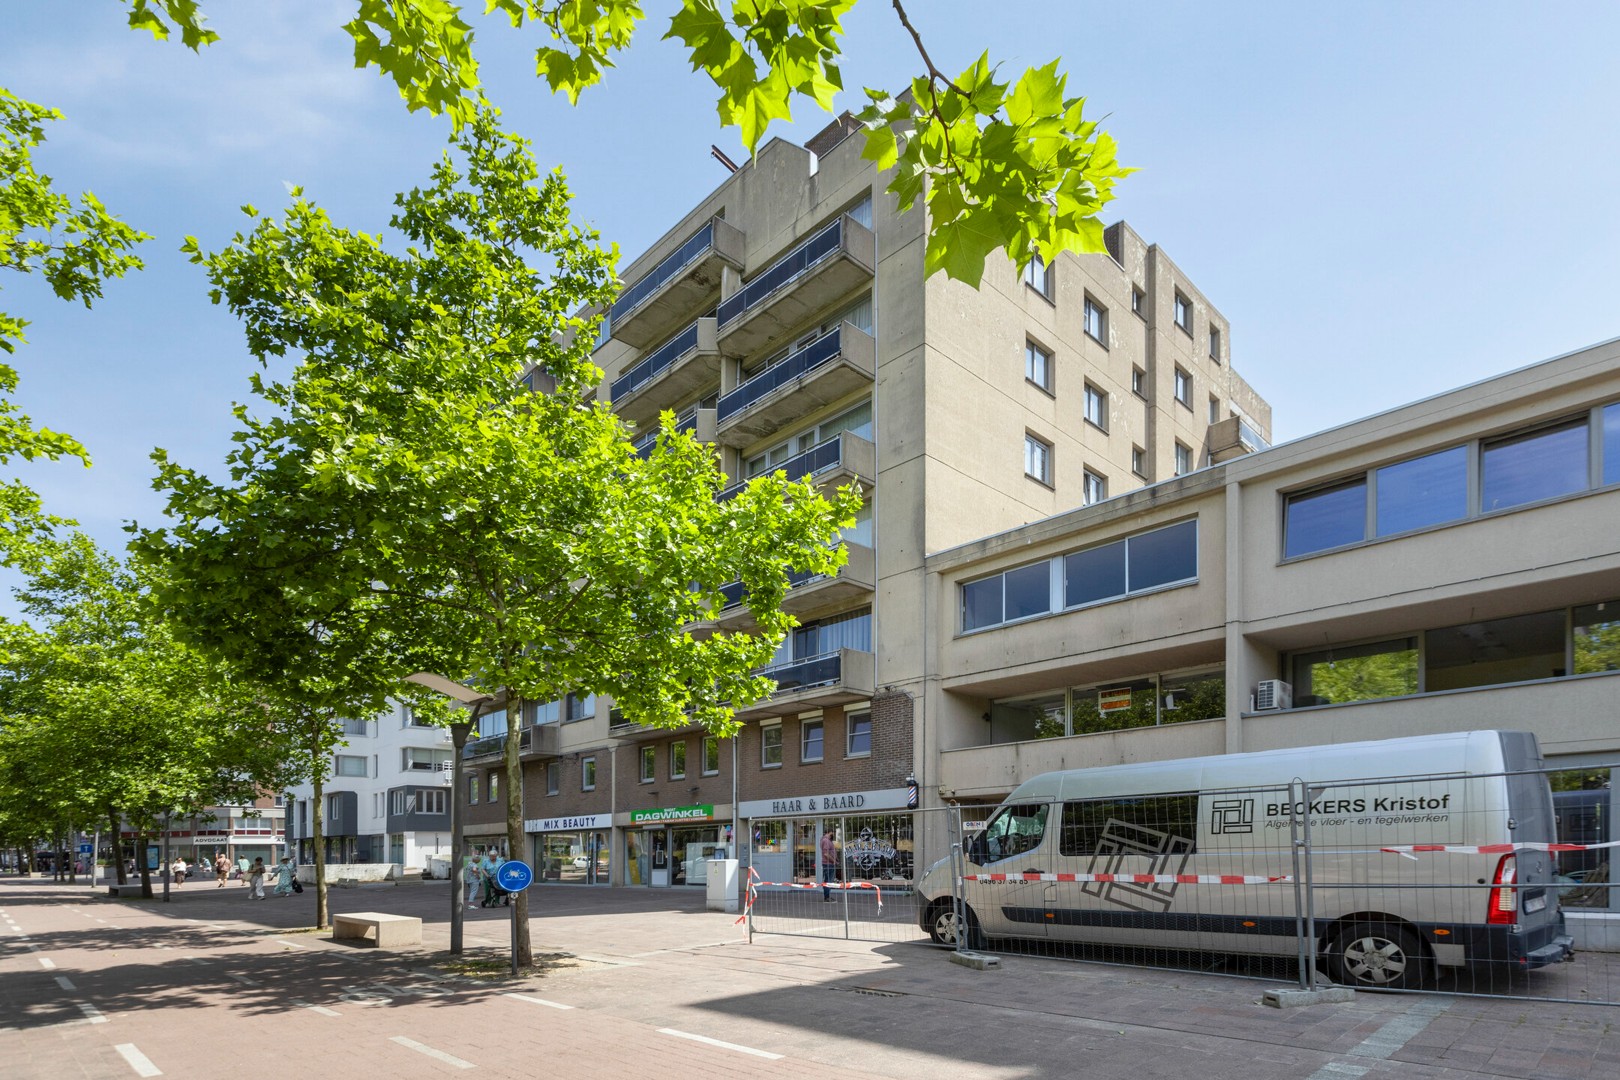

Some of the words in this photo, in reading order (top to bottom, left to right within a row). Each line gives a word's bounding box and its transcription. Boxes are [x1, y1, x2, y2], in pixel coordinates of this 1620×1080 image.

[772, 799, 802, 813] HAAR
[808, 798, 817, 811] &
[823, 794, 865, 810] BAARD
[1266, 798, 1366, 817] BECKERS
[1374, 793, 1451, 812] Kristof
[635, 808, 708, 821] DAGWINKEL
[1320, 817, 1347, 826] vloer
[1357, 817, 1372, 825] en
[1375, 813, 1449, 827] tegelwerken
[543, 820, 560, 830] MIX
[562, 816, 597, 829] BEAUTY
